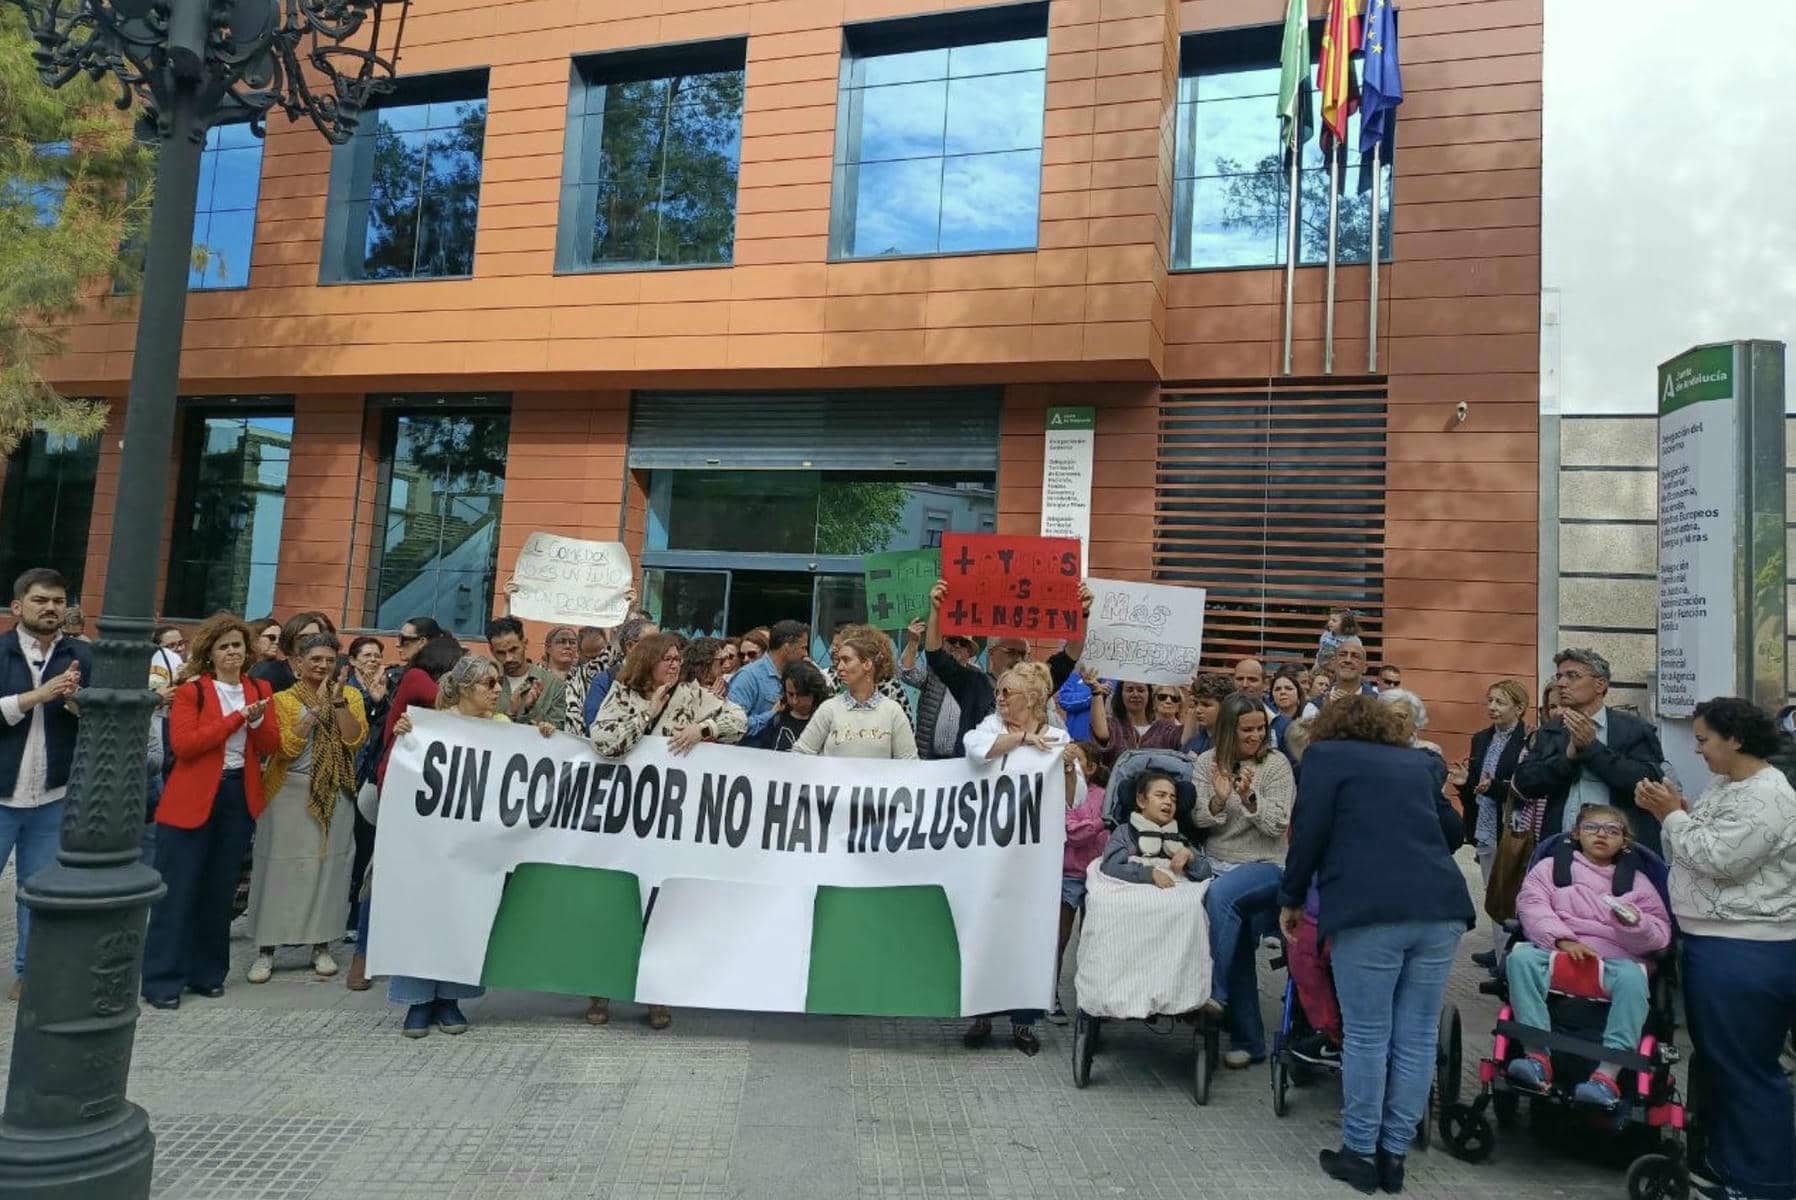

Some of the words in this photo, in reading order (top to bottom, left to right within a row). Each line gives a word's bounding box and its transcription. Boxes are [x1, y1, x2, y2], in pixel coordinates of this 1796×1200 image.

[415, 741, 492, 822] SIN
[499, 753, 687, 840] COMEDOR
[694, 773, 752, 848] NO
[761, 780, 840, 853] HAY
[847, 754, 1044, 854] INCLUSIÓN
